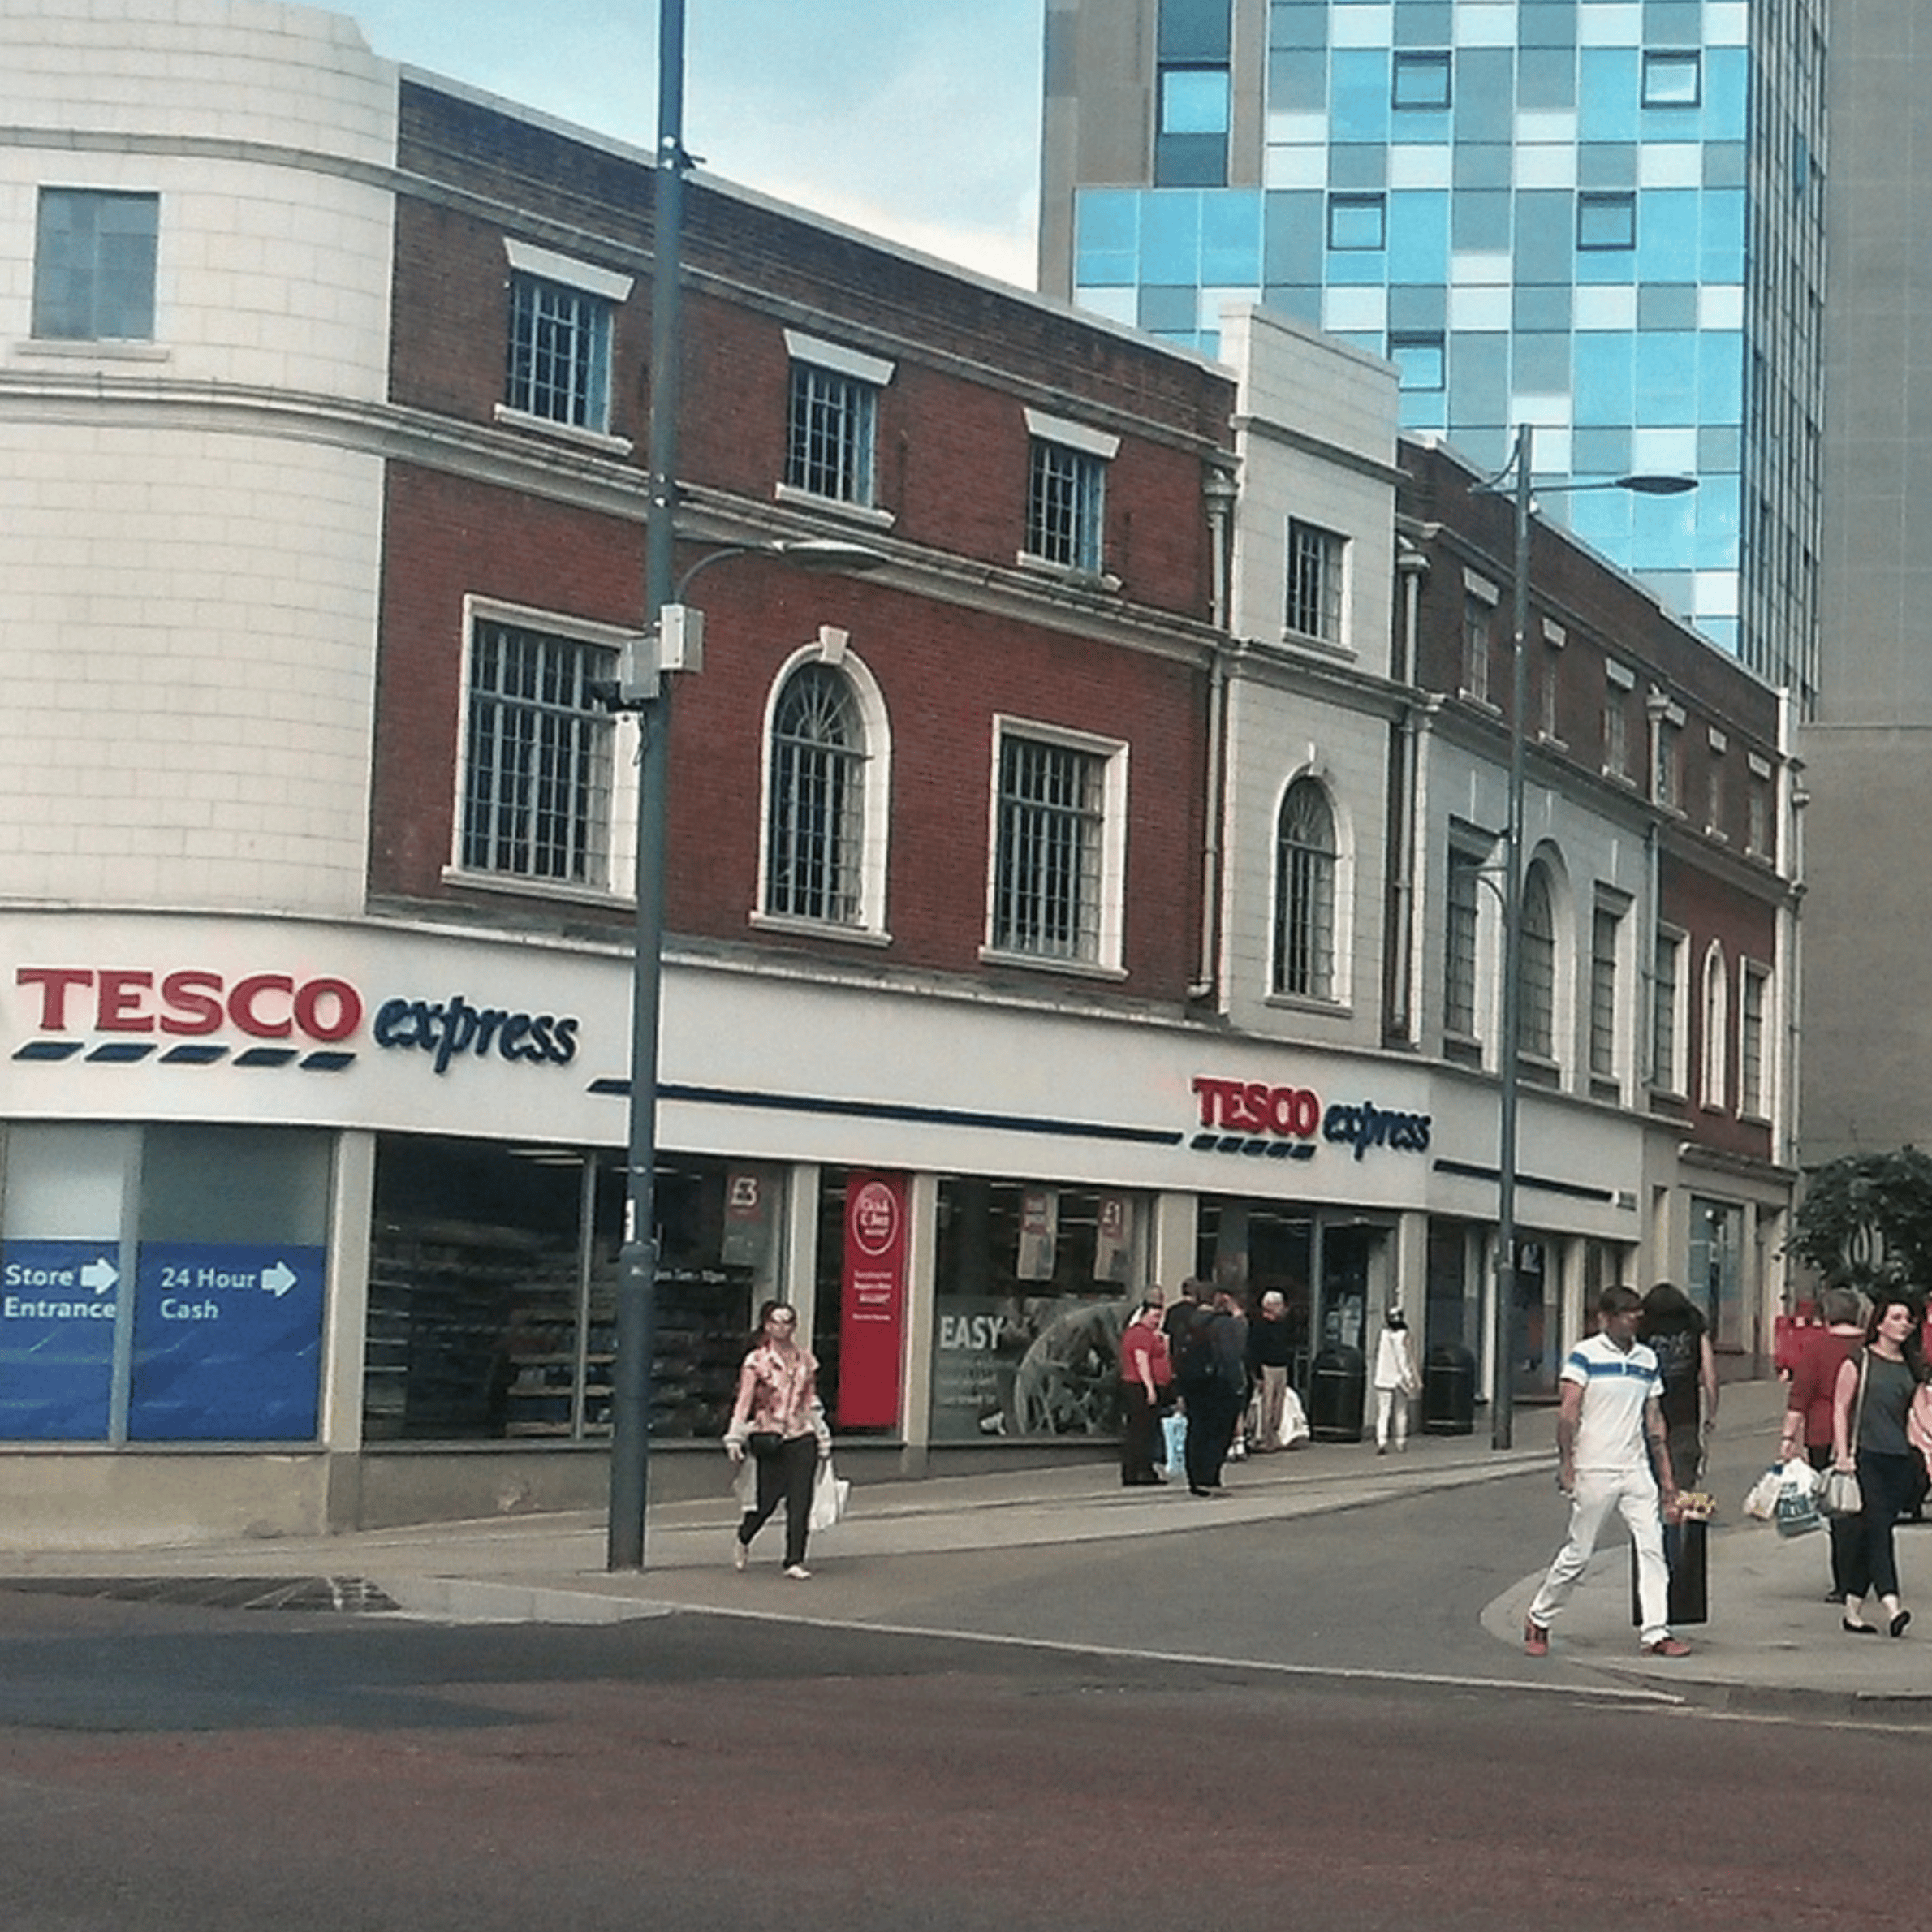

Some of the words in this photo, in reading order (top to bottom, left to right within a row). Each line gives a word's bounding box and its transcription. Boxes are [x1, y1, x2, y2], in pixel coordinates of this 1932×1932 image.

[16, 968, 363, 1041] TESCO
[374, 996, 578, 1073] express
[1192, 1077, 1321, 1138] TESCO
[1323, 1101, 1432, 1160] express
[5, 1264, 74, 1286] Store
[161, 1267, 191, 1287] 24
[197, 1267, 257, 1288] Hour
[4, 1296, 117, 1318] Entrance
[161, 1298, 218, 1319] Cash
[940, 1316, 1004, 1349] EASY
